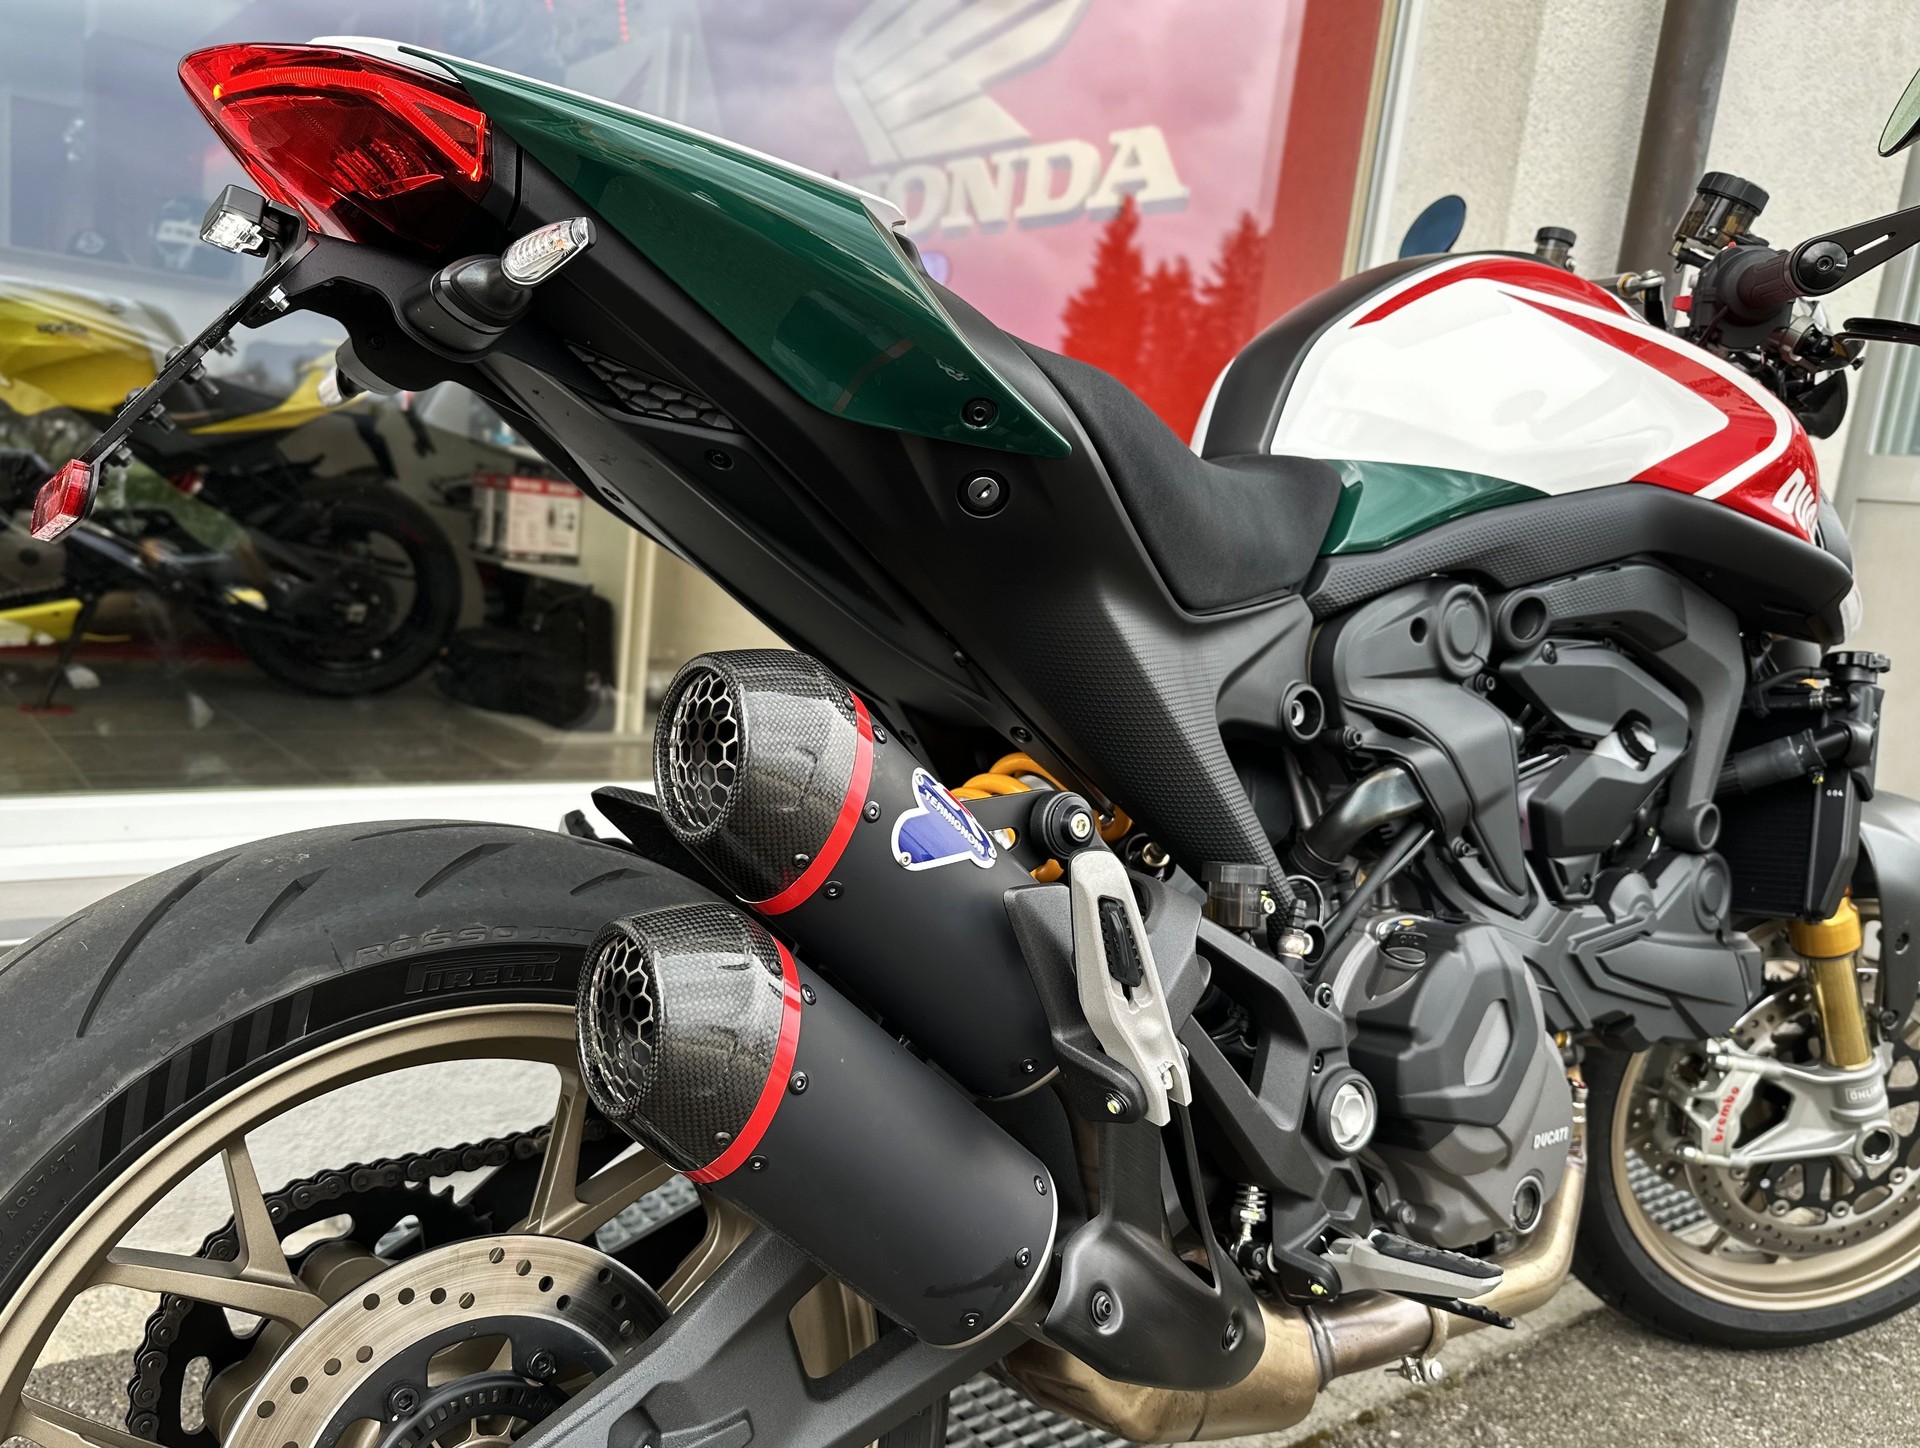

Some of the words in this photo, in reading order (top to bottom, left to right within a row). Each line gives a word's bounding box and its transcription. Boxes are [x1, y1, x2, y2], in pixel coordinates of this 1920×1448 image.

[856, 125, 1190, 236] ONDA
[924, 789, 985, 855] TERMIGNONI
[353, 925, 519, 967] ROSSO
[404, 951, 561, 995] PIRELLI
[1533, 1126, 1569, 1150] DUCATI
[1711, 1086, 1740, 1143] brembo
